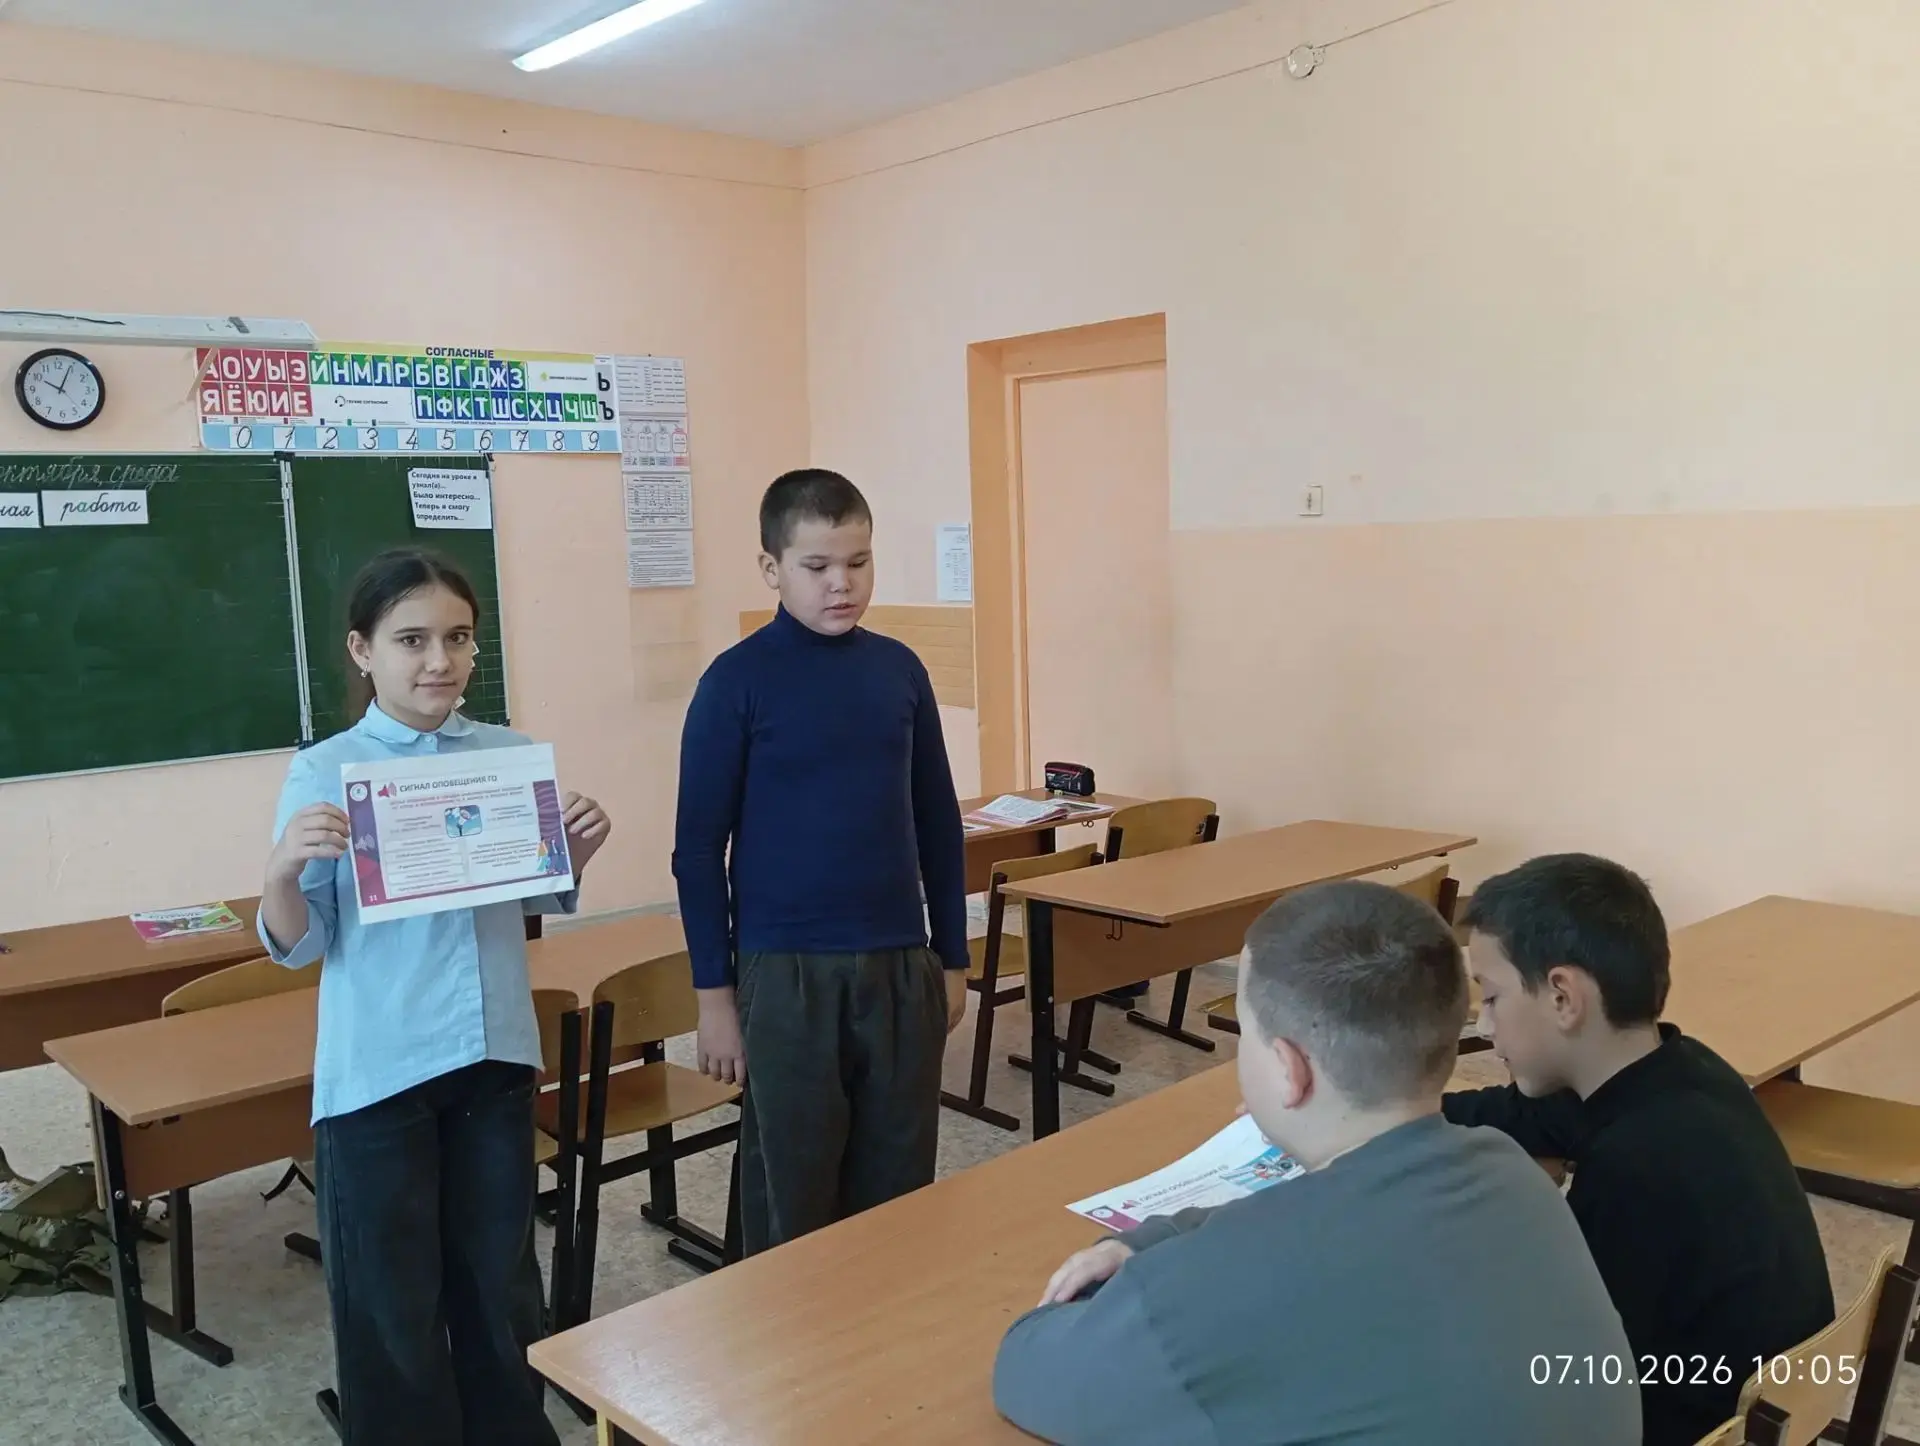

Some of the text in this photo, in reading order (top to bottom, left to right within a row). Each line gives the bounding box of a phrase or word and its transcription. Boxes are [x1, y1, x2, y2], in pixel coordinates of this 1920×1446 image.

[425, 347, 495, 359] СОГЛАСНЫЕ
[42, 365, 49, 373] 11
[54, 361, 62, 369] 12
[34, 372, 42, 381] 10
[204, 355, 523, 389] А О У Ы Э Й Н М Л Р Б В Г Д Ж З
[80, 374, 86, 383] 2
[29, 386, 36, 394] 9
[85, 386, 90, 395] 3
[35, 397, 41, 405] 8
[202, 384, 309, 414] Я Ё Ю И Е
[45, 406, 52, 414] 7
[72, 407, 78, 415] 5
[417, 395, 598, 422] П Ф К Т Ш С Х Ц Ч Щ
[59, 410, 66, 418] 6
[237, 426, 252, 449] 0
[285, 426, 295, 449] 1
[322, 427, 338, 449] 2
[363, 427, 379, 450] 3
[406, 428, 418, 450] 4
[441, 429, 456, 450] 5
[480, 430, 493, 450] 6
[516, 430, 529, 450] 7
[553, 431, 564, 451] 8
[588, 431, 599, 451] 9
[411, 471, 440, 480] Сегодня
[413, 491, 433, 499] Было
[60, 493, 141, 522] работа
[414, 502, 440, 511] Теперь
[448, 504, 471, 512] смогу
[400, 783, 430, 793] СИГНАЛ
[432, 776, 486, 789] ОПОВЕЩЕНИЯ
